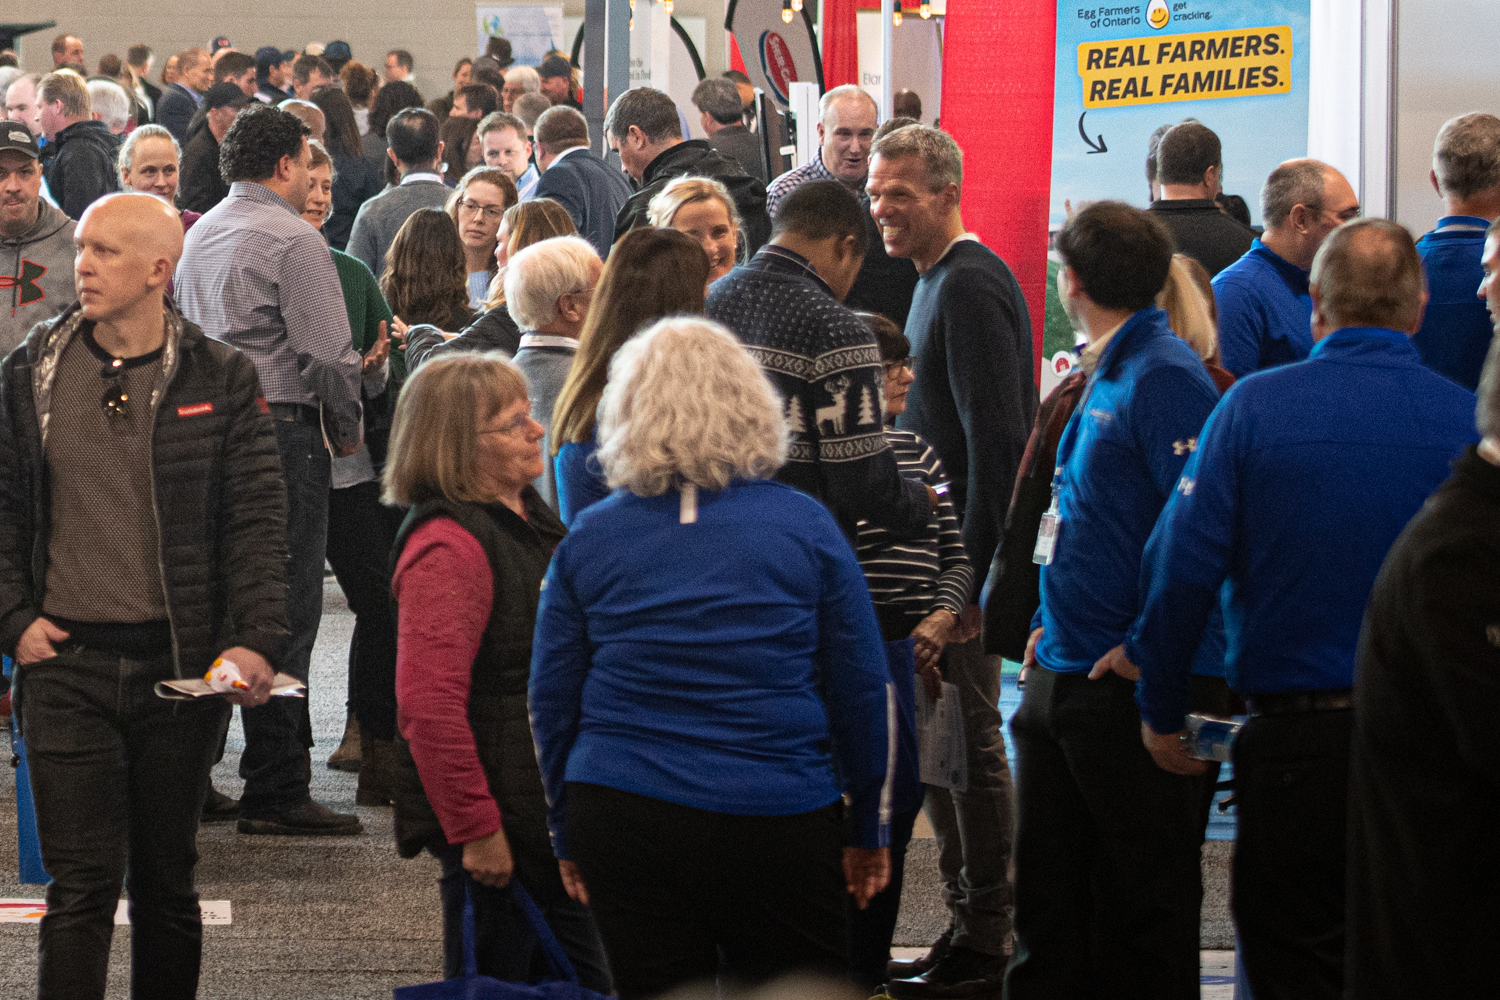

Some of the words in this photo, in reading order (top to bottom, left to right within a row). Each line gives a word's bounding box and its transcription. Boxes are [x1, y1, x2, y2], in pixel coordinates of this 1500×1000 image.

[1077, 8, 1097, 20] Egg
[1098, 5, 1140, 17] Farmers
[1173, 2, 1187, 12] get
[1090, 18, 1100, 28] of
[1100, 16, 1141, 28] Ontario
[1086, 44, 1150, 71] REAL
[1156, 33, 1285, 65] FARMERS.
[1089, 76, 1153, 102] REAL
[1159, 65, 1284, 96] FAMILIES.
